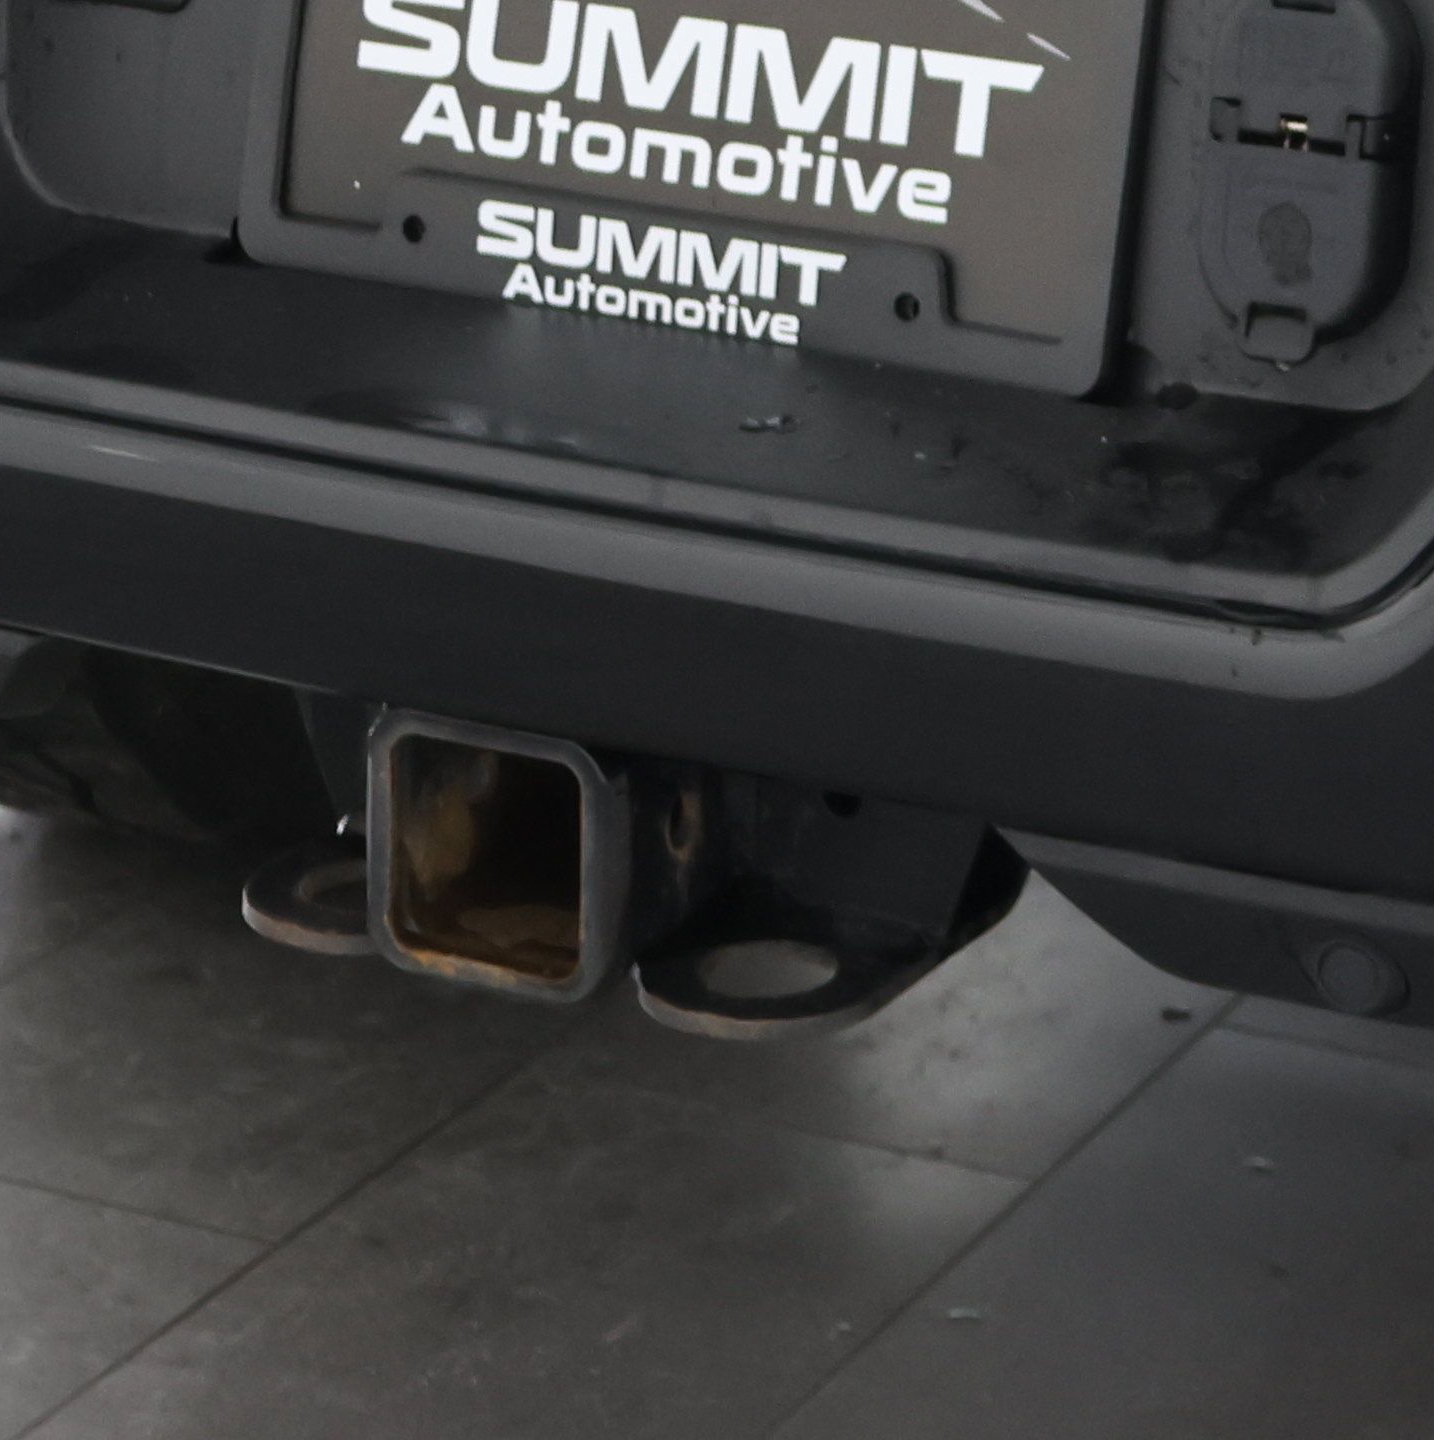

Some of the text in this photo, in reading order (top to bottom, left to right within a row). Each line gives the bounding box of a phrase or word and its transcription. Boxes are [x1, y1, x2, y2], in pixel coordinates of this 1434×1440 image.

[400, 82, 953, 225] Automotive
[476, 199, 847, 307] SUMMIT
[502, 262, 801, 346] Automotive
